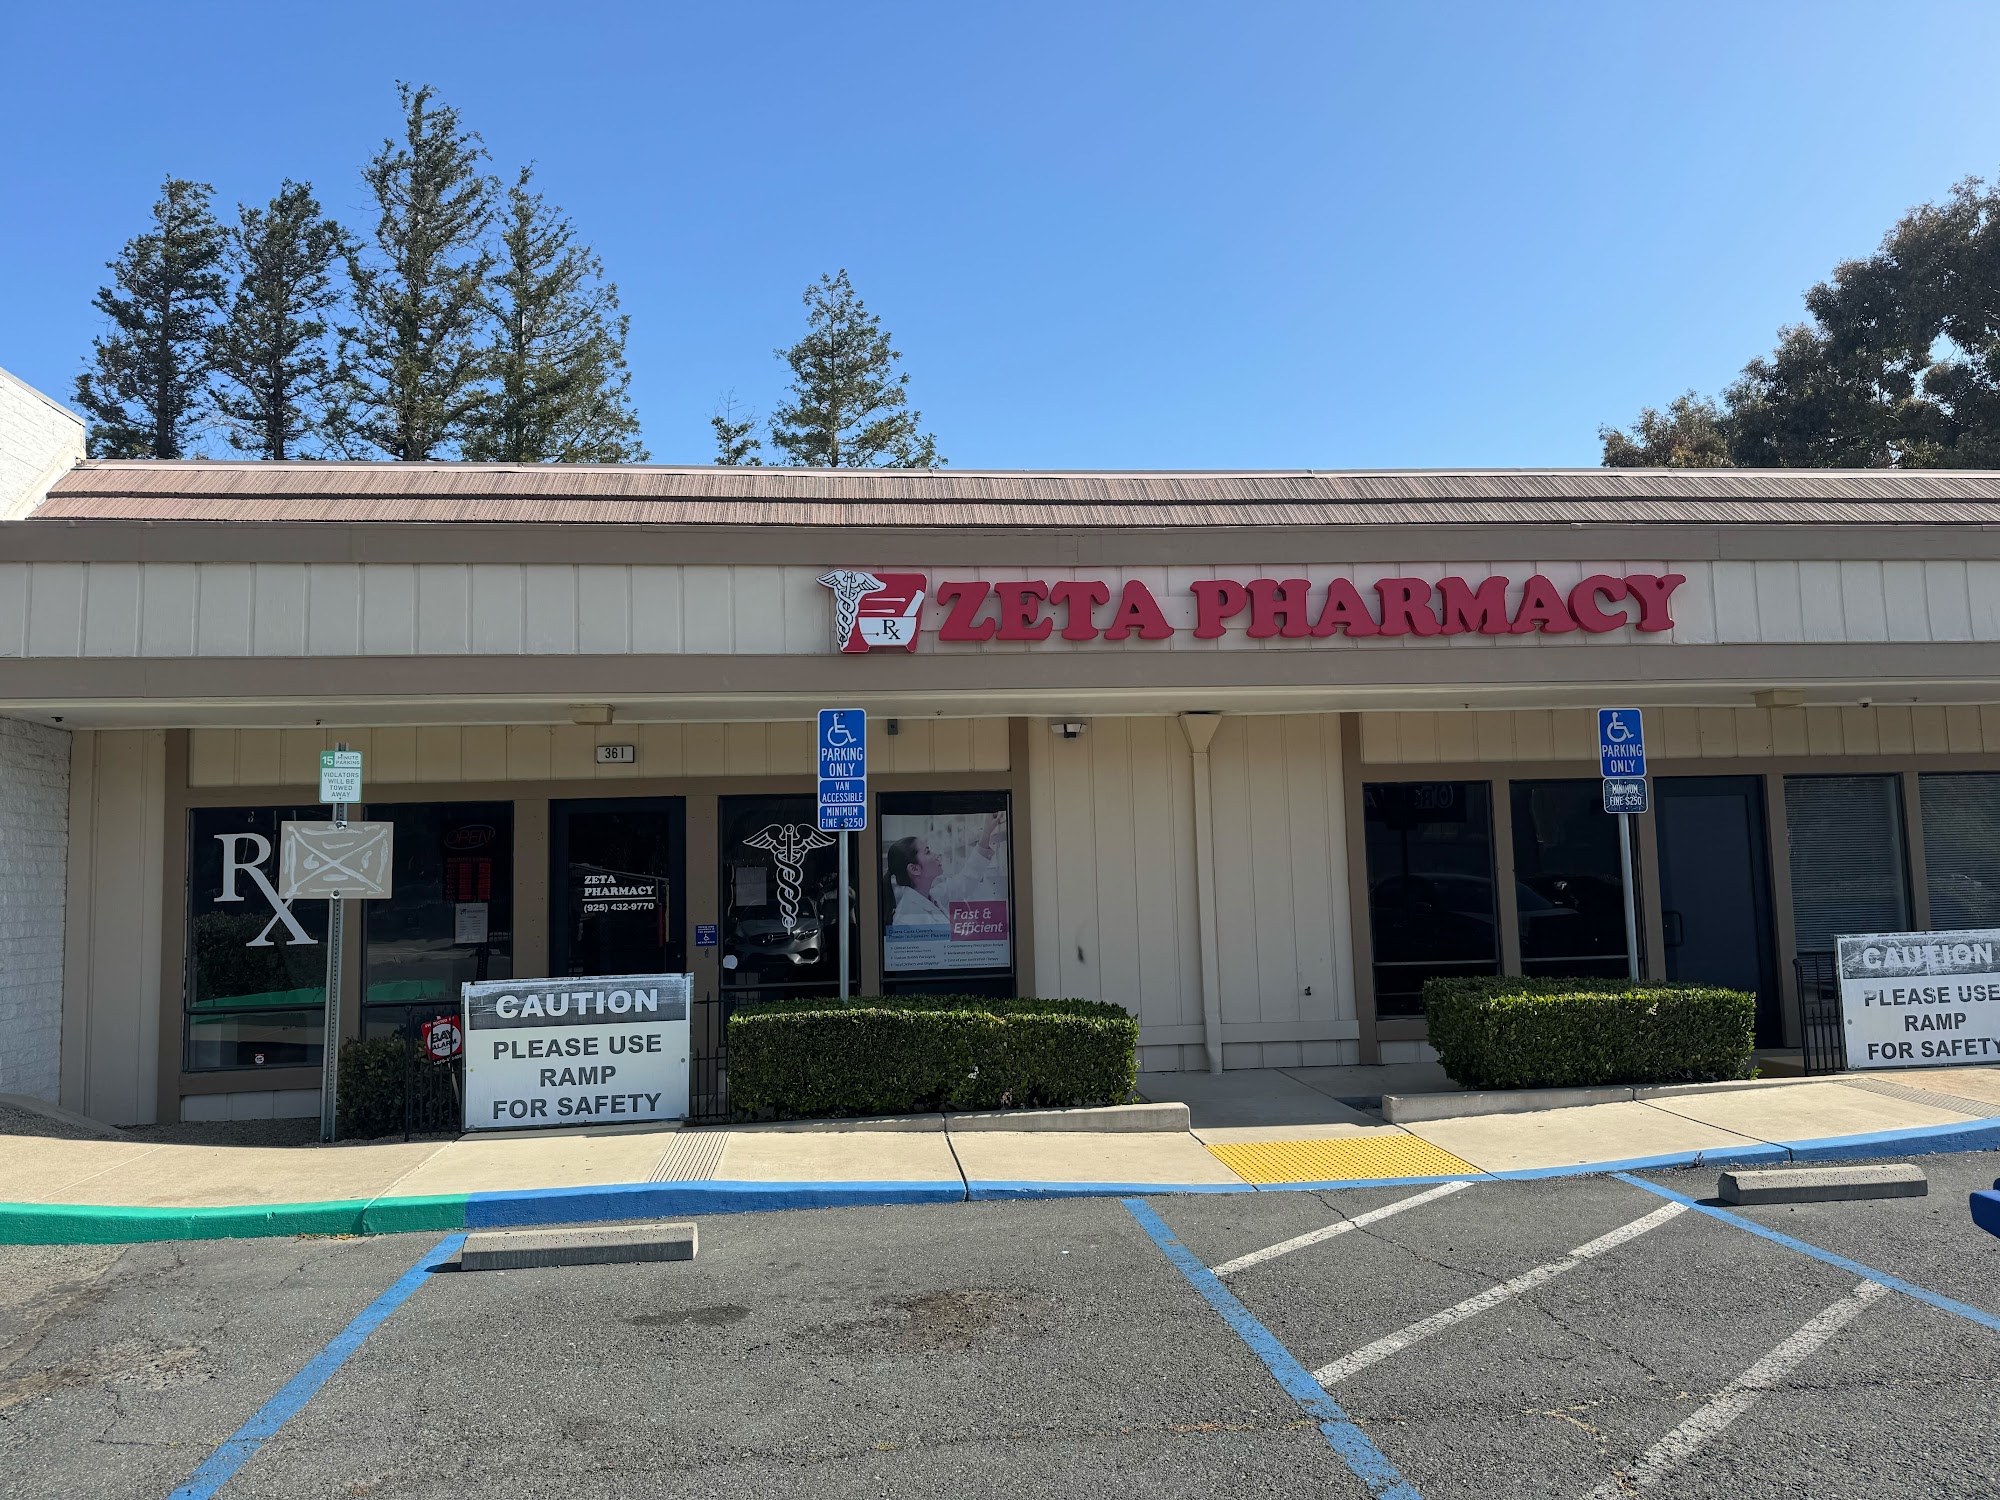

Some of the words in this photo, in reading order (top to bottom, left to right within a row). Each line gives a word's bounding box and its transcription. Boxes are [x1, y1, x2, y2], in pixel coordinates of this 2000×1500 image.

[937, 580, 1175, 641] ZETA
[1189, 574, 1686, 639] PHARMACY
[882, 619, 901, 640] Rx
[605, 747, 624, 759] 361
[821, 747, 864, 761] PARKING
[1602, 744, 1643, 758] PARKING
[322, 756, 334, 765] 15
[1610, 760, 1636, 773] ONLY
[829, 763, 855, 777] ONLY
[835, 782, 850, 791] VAN
[1612, 784, 1638, 794] MINIMUM
[822, 792, 863, 803] ACCESSIBLE
[1610, 797, 1624, 806] FINE
[1625, 796, 1642, 806] $250
[826, 806, 858, 817] MINIMUM
[822, 818, 838, 828] FINE
[844, 818, 864, 828] $250
[584, 874, 617, 884] ZETA
[584, 886, 654, 896] PHARMACY
[584, 904, 608, 914] (925)
[610, 902, 654, 911] 432-9770
[954, 908, 980, 920] Fast
[982, 908, 992, 920] &
[954, 922, 1004, 936] Efficient
[1862, 942, 1992, 968] CAUTION
[1864, 986, 1950, 1006] PLEASE
[1958, 984, 2000, 1002] USE
[496, 988, 658, 1018] CAUTION
[1904, 1012, 1967, 1032] RAMP
[494, 1037, 599, 1060] PLEASE
[609, 1034, 662, 1054] USE
[1868, 1042, 1914, 1060] FOR
[1921, 1038, 2000, 1058] SAFETY
[540, 1066, 616, 1088] RAMP
[493, 1098, 548, 1120] FOR
[557, 1092, 662, 1116] SAFETY
